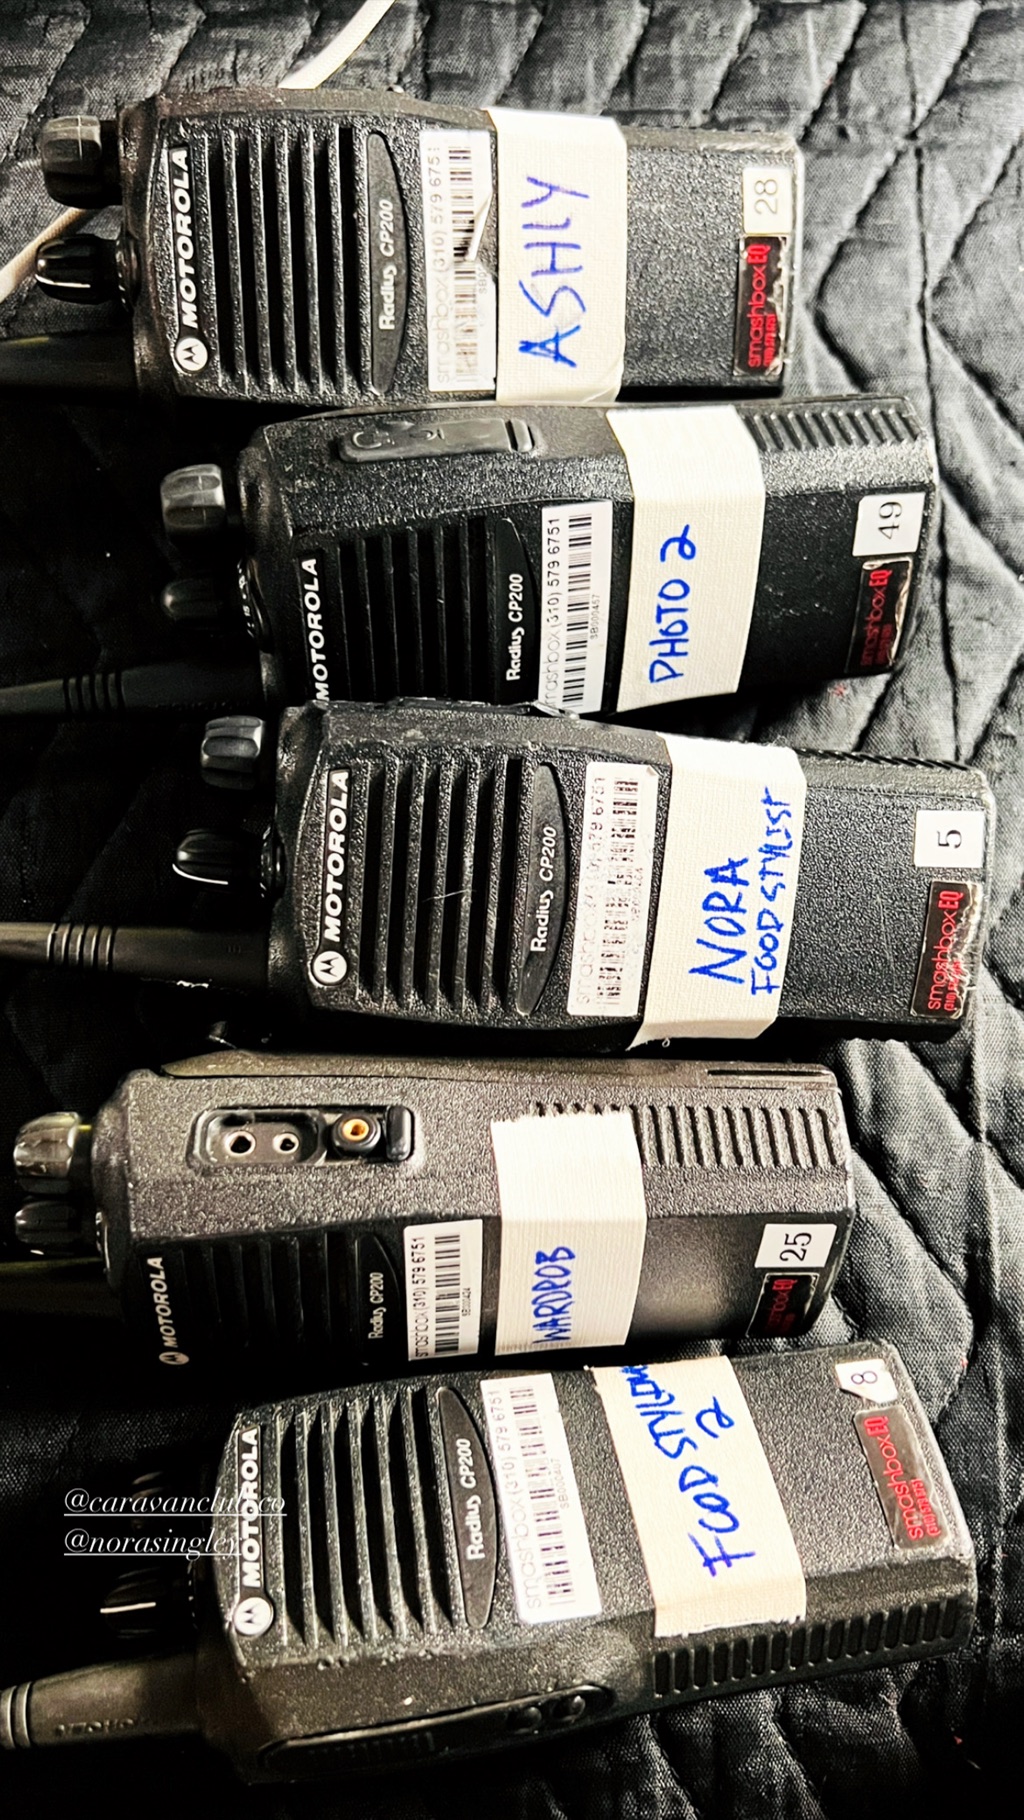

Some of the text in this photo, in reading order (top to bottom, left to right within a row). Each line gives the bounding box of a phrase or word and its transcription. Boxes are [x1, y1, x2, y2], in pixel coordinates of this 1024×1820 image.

[754, 179, 778, 214] 28
[172, 149, 198, 328] MOTOROLA
[379, 199, 398, 330] Radius CP200
[518, 176, 589, 368] ASHLY
[548, 518, 560, 554] 6751
[878, 501, 903, 540] 49
[548, 561, 560, 588] 579
[649, 524, 696, 683] PHOTO 2
[302, 557, 330, 702] MOTOROLA
[506, 573, 525, 681] Radius CP200
[543, 630, 561, 707] mashbox
[323, 771, 349, 943] MOTOROLA
[937, 829, 962, 849] 5
[530, 826, 557, 952] Radius CP200
[689, 857, 749, 984] NORA
[750, 786, 792, 996] FOOD STYLIST
[410, 1236, 426, 1264] 6751
[411, 1266, 427, 1285] 579
[779, 1232, 812, 1262] 25
[147, 1257, 179, 1348] MOTOROLA
[368, 1272, 387, 1339] Radius CP200
[488, 1389, 506, 1422] 6751
[850, 1369, 878, 1385] 8
[494, 1425, 512, 1452] 579
[695, 1396, 735, 1439] 2
[240, 1428, 261, 1588] MOTOROLA
[456, 1438, 486, 1561] Radius CP200
[501, 1454, 524, 1496] (310)
